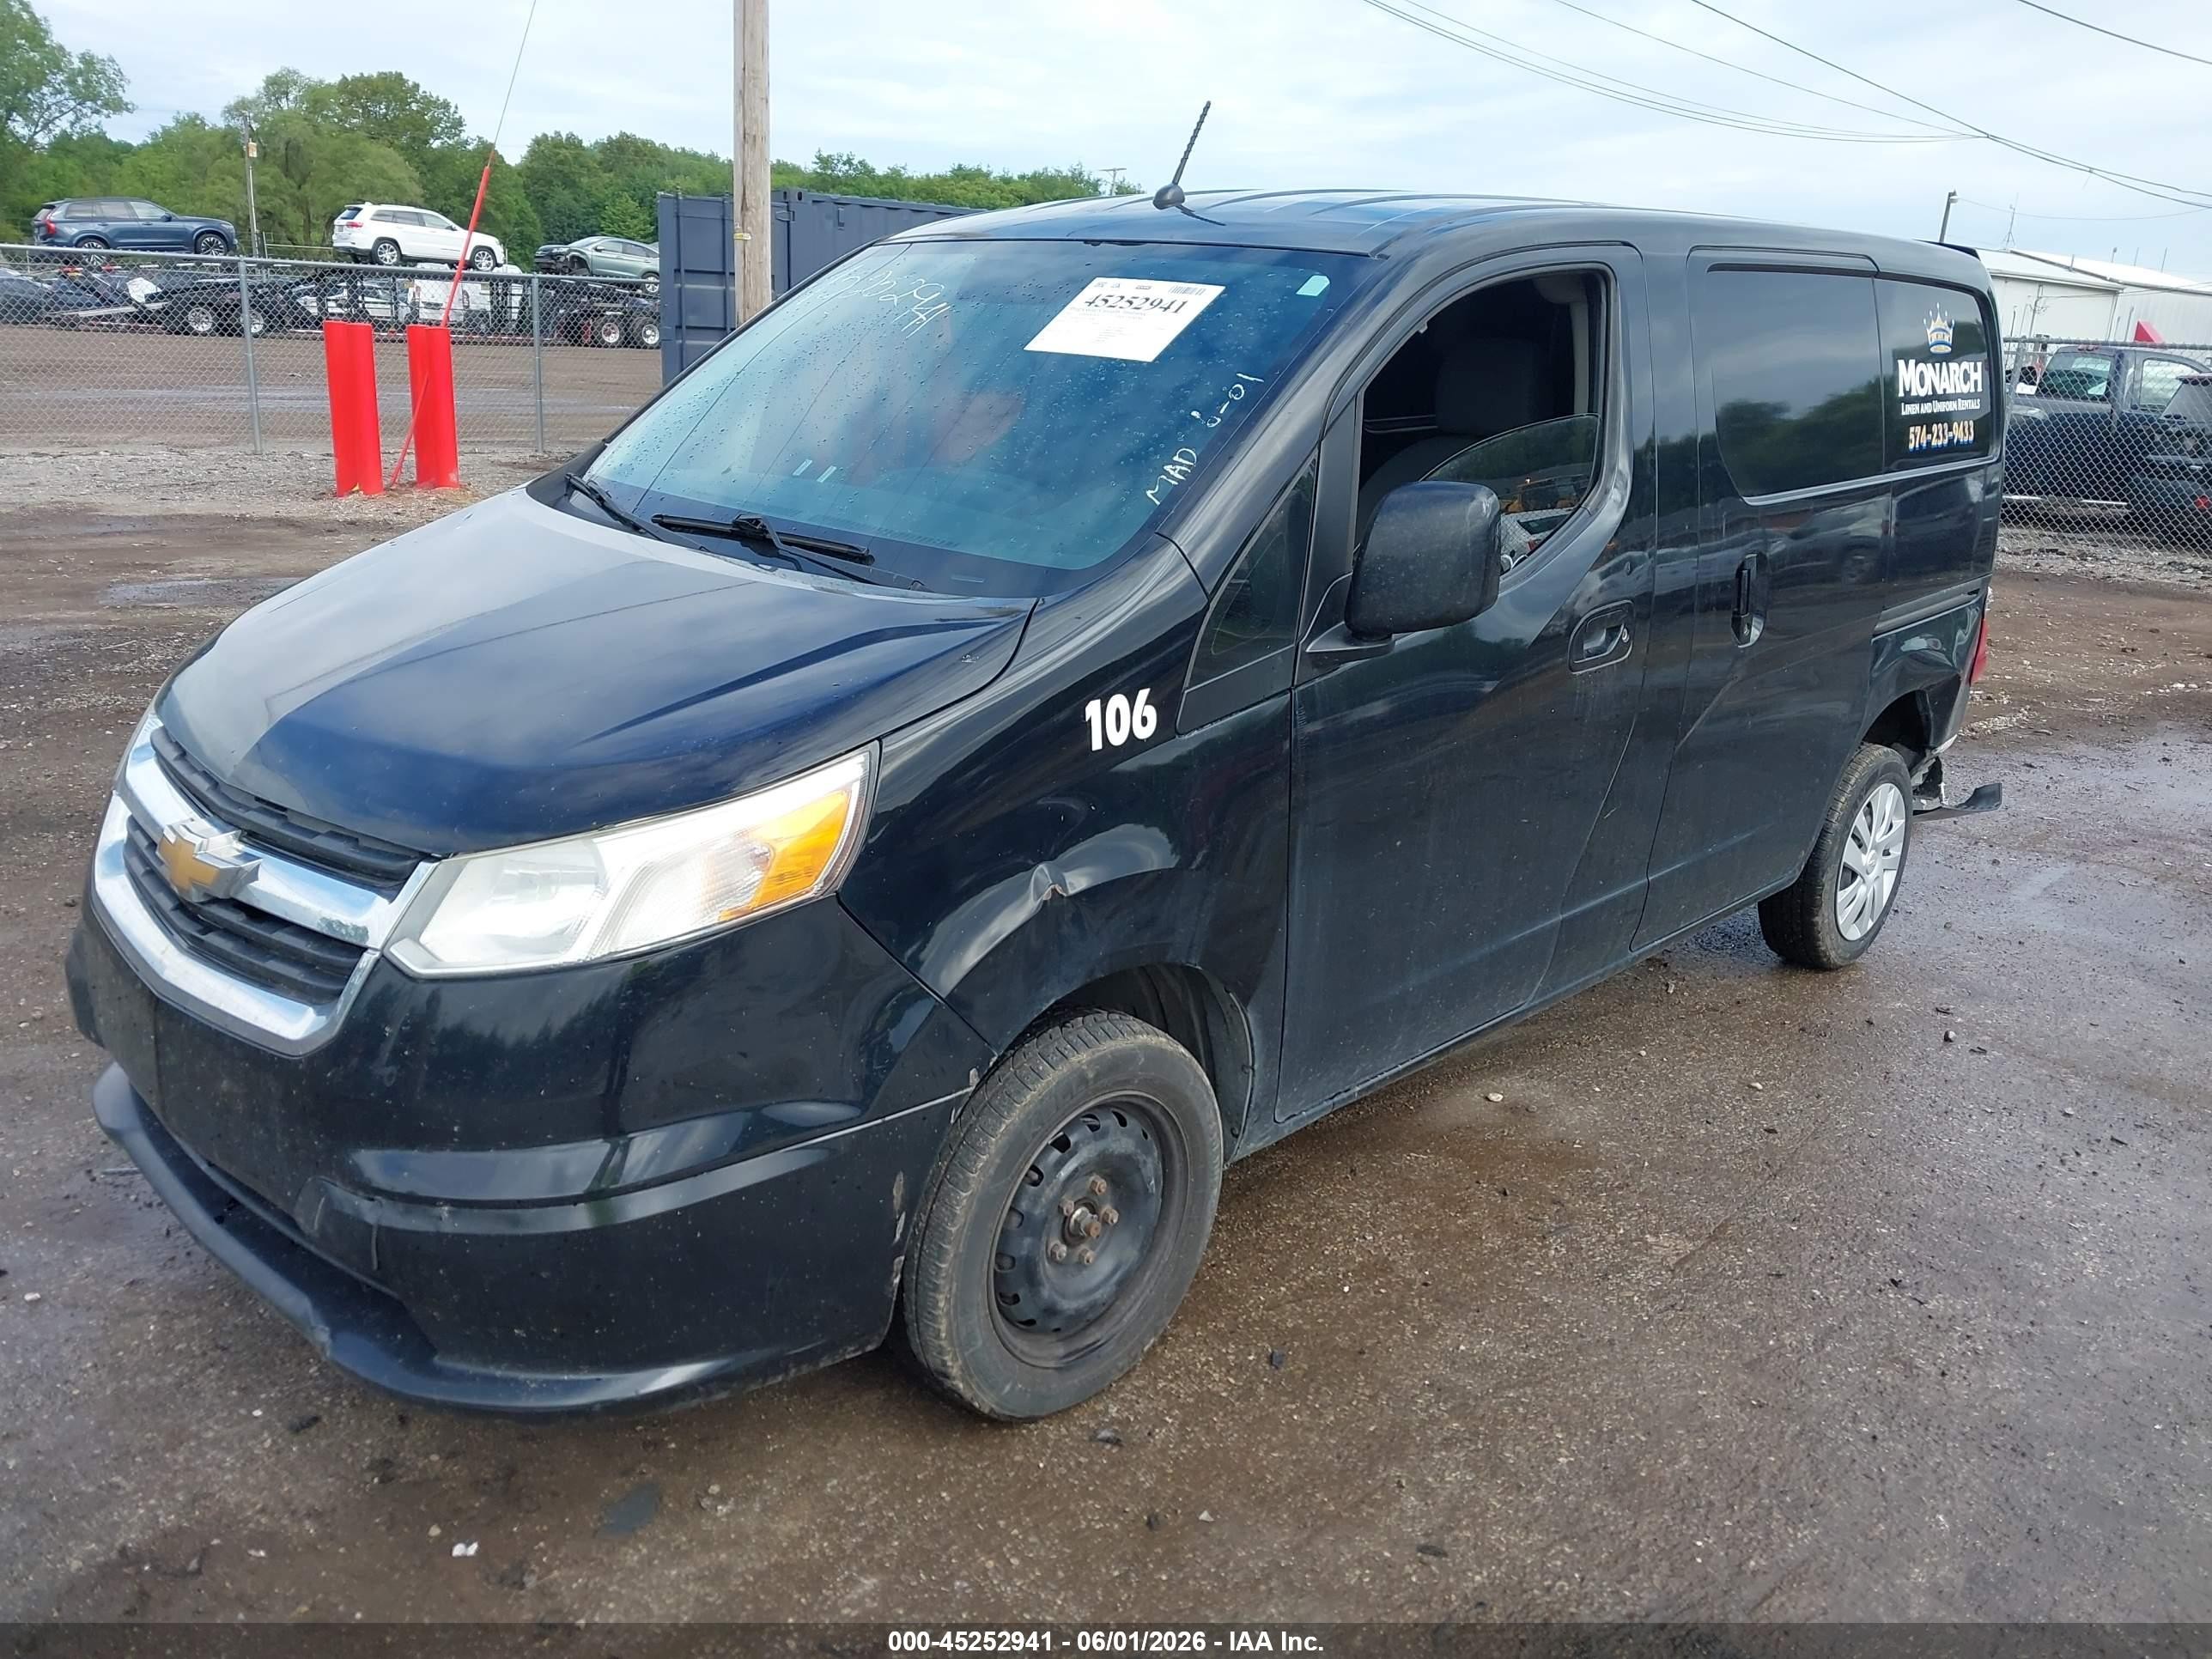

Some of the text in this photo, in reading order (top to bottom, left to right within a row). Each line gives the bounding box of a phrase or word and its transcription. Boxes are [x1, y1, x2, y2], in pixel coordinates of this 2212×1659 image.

[1085, 294, 1188, 313] 45252941
[1898, 359, 1983, 397] MONARCH
[1920, 403, 1932, 414] AND
[1957, 398, 1980, 410] RENTALS
[1908, 420, 1974, 452] 574-233-9433
[1085, 688, 1158, 751] 106
